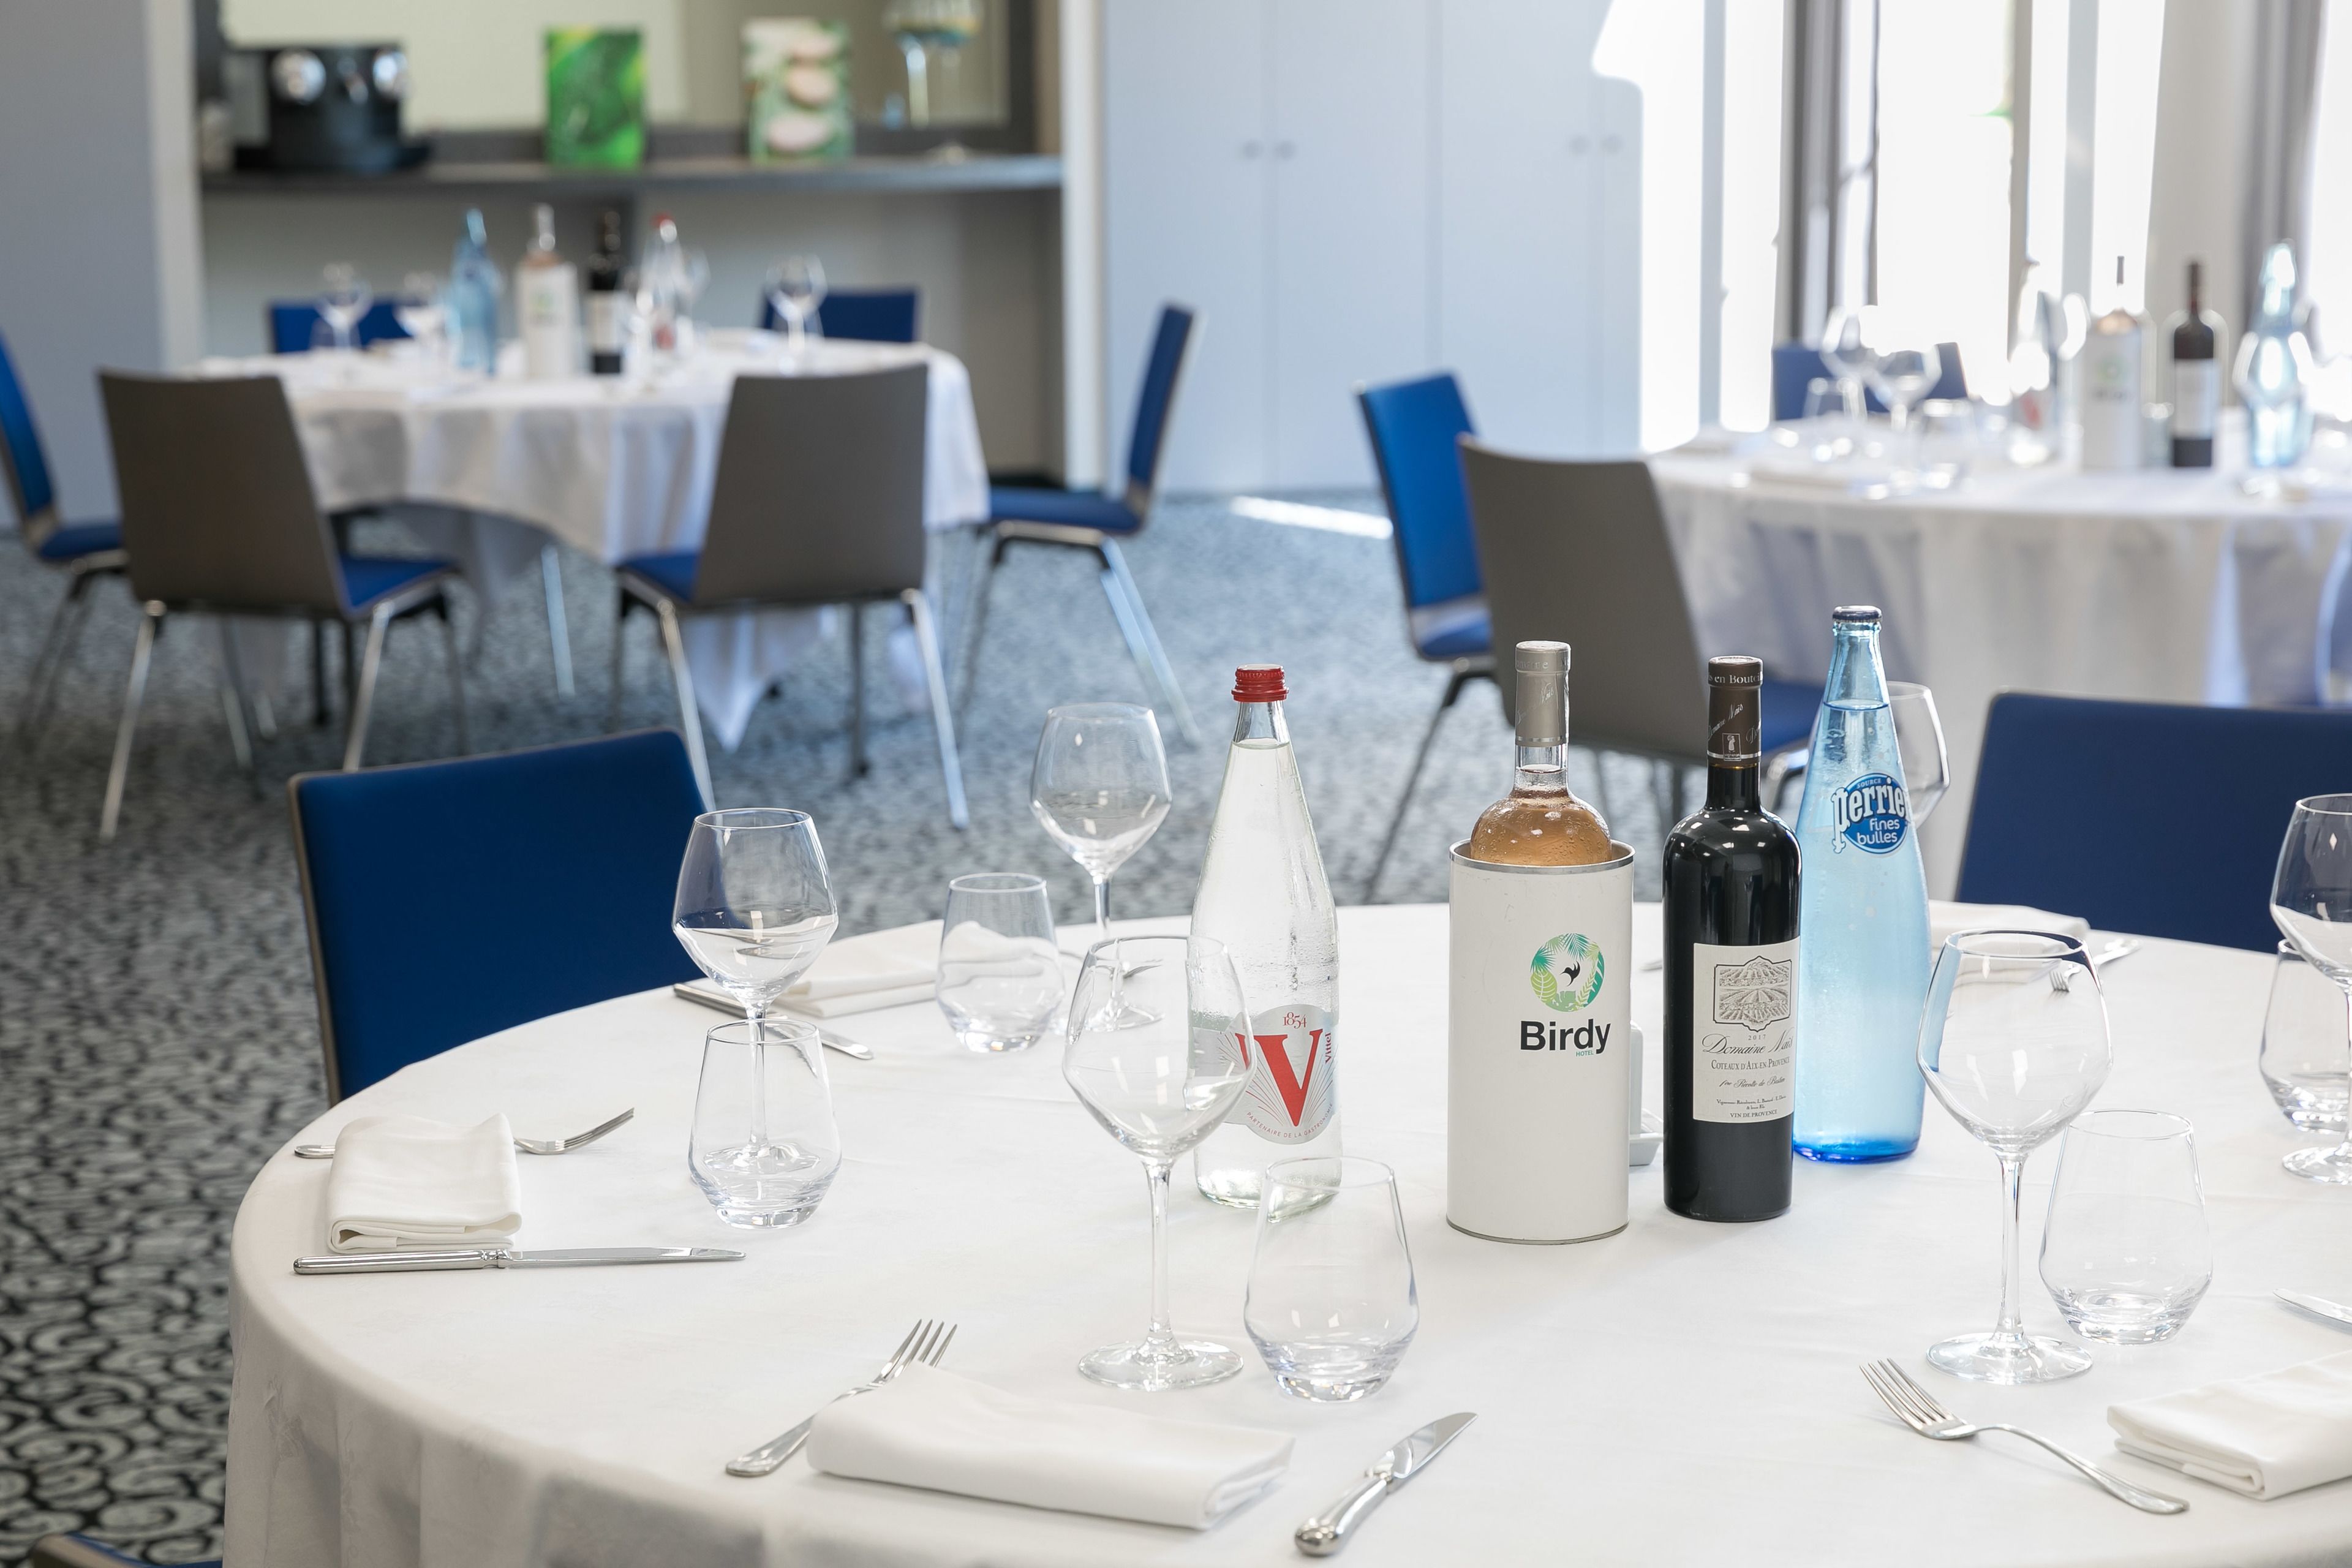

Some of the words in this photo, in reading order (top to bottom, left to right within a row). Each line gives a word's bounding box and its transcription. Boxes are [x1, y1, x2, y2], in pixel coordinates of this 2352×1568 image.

[1729, 673, 1760, 684] Boutei
[1857, 778, 1882, 788] SOURCE
[1869, 818, 1900, 831] fines
[1856, 831, 1898, 845] bulles
[1283, 1012, 1307, 1028] 1854
[1520, 1018, 1611, 1054] Birdy
[1702, 1033, 1766, 1054] Domaine
[1253, 1029, 1323, 1127] V
[1247, 1112, 1281, 1137] PARTENAIRE
[1304, 1103, 1333, 1136] GASTRONOMIE
[1751, 1109, 1777, 1118] PROVENCE
